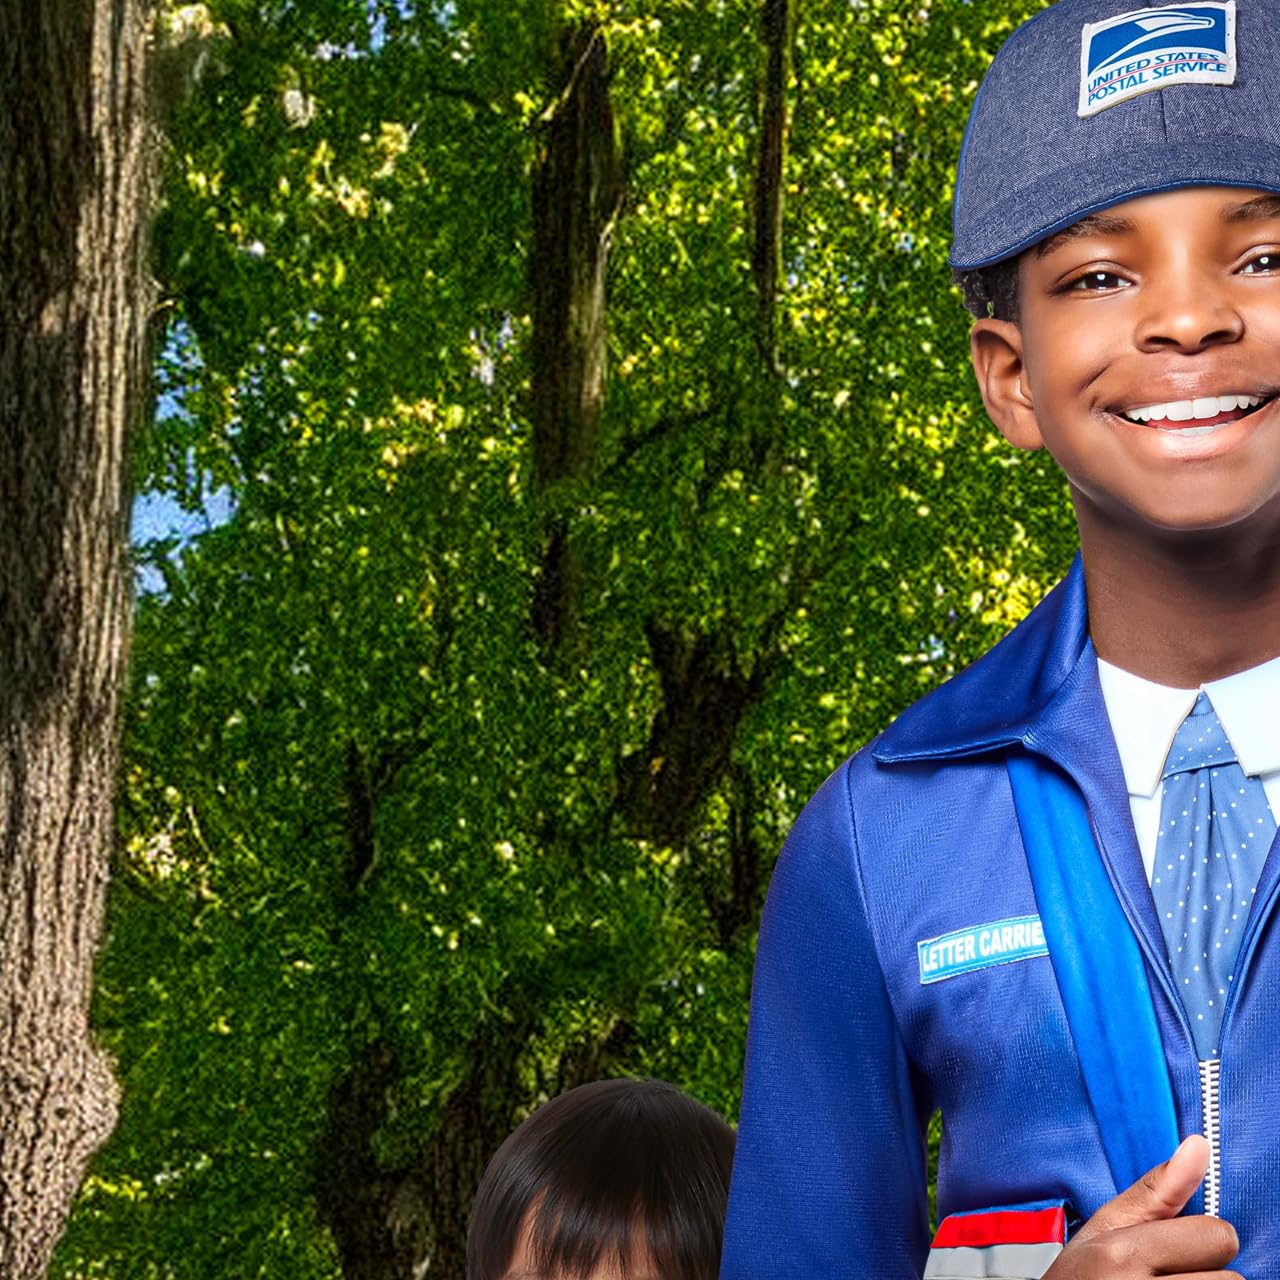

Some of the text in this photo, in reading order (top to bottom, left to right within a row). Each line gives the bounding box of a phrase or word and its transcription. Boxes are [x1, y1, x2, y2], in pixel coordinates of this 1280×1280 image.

[1088, 52, 1220, 93] UNITED STATES
[1088, 61, 1226, 106] POSTAL SERVICE
[923, 920, 1047, 972] LETTER CARRIE
